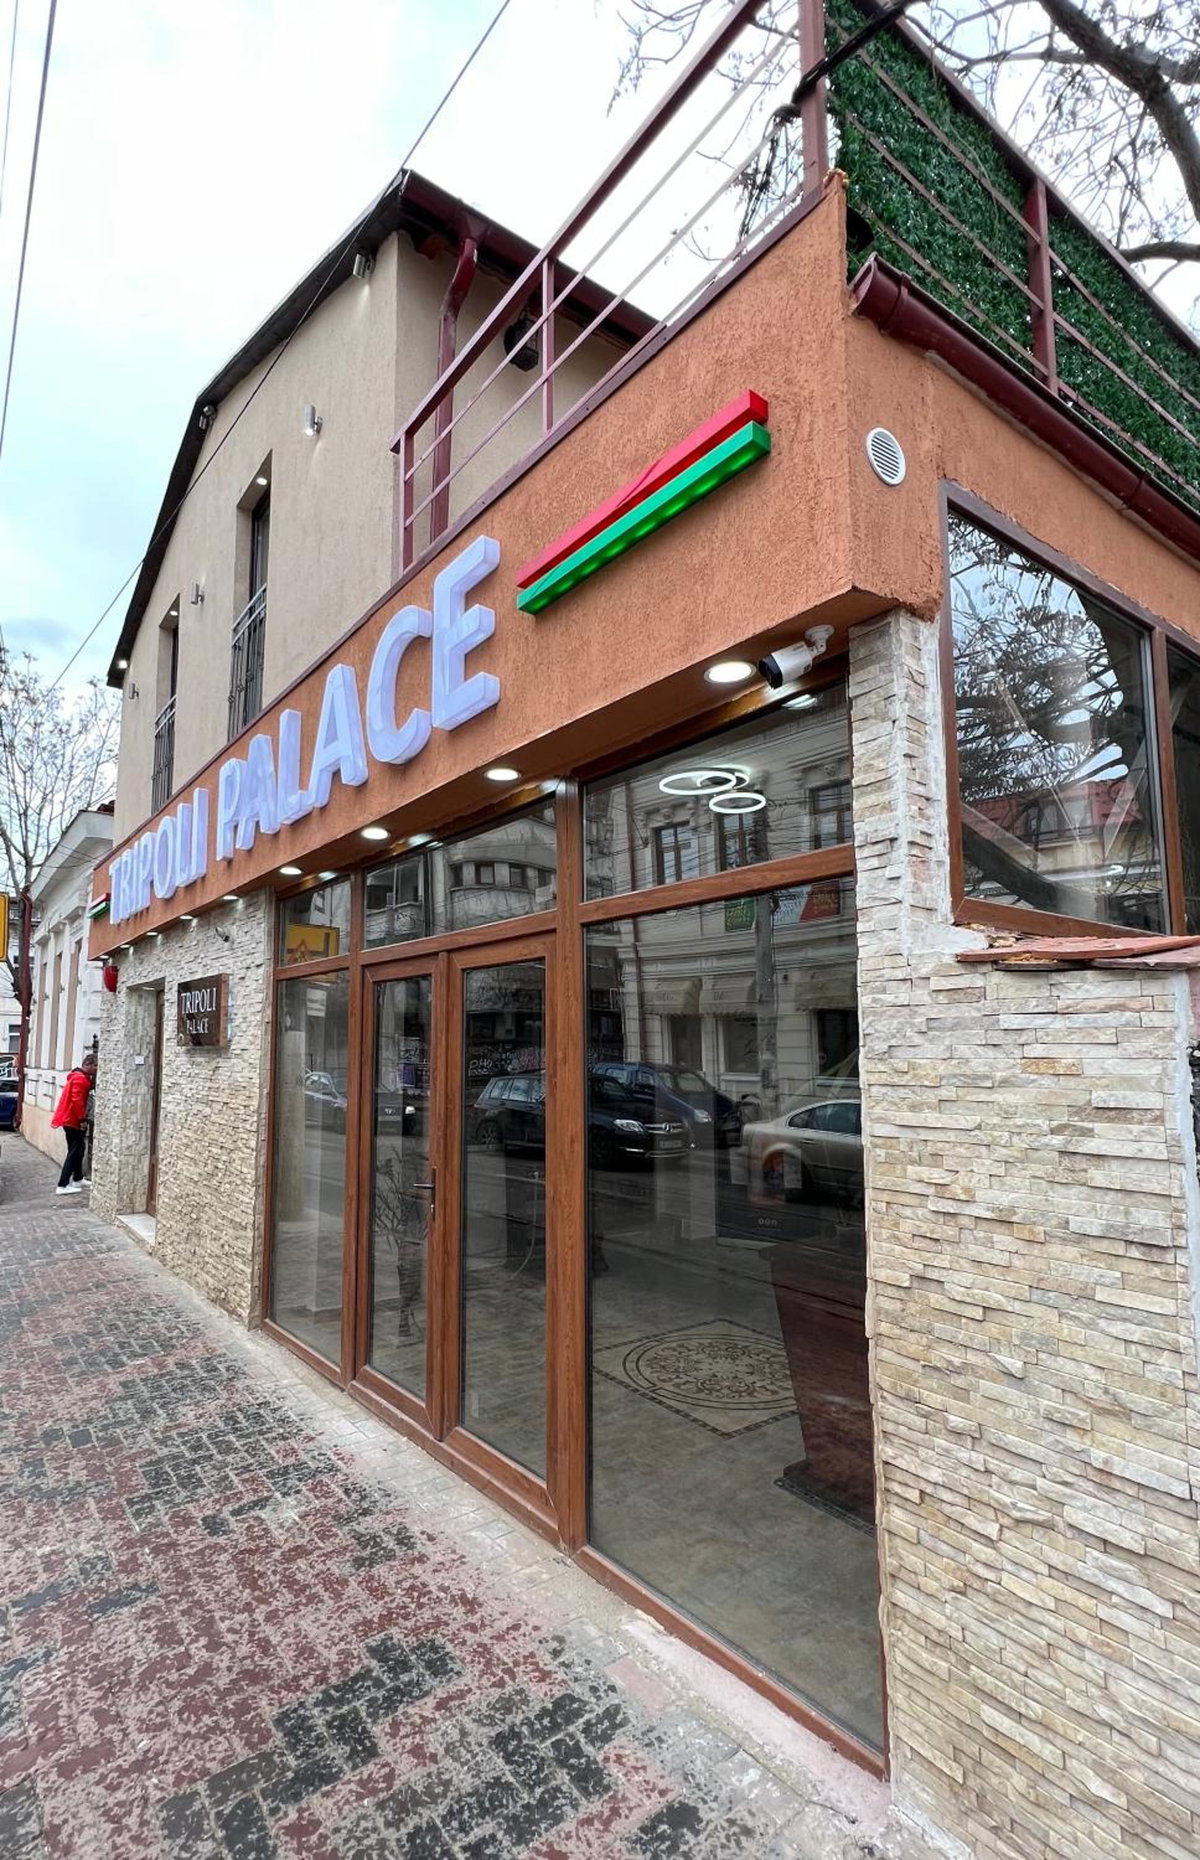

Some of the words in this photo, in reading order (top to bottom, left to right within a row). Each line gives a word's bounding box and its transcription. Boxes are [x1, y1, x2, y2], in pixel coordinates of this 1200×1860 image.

[109, 788, 209, 926] TRIPOLI
[216, 534, 500, 862] PALACE
[181, 987, 217, 1014] TRIPOLI
